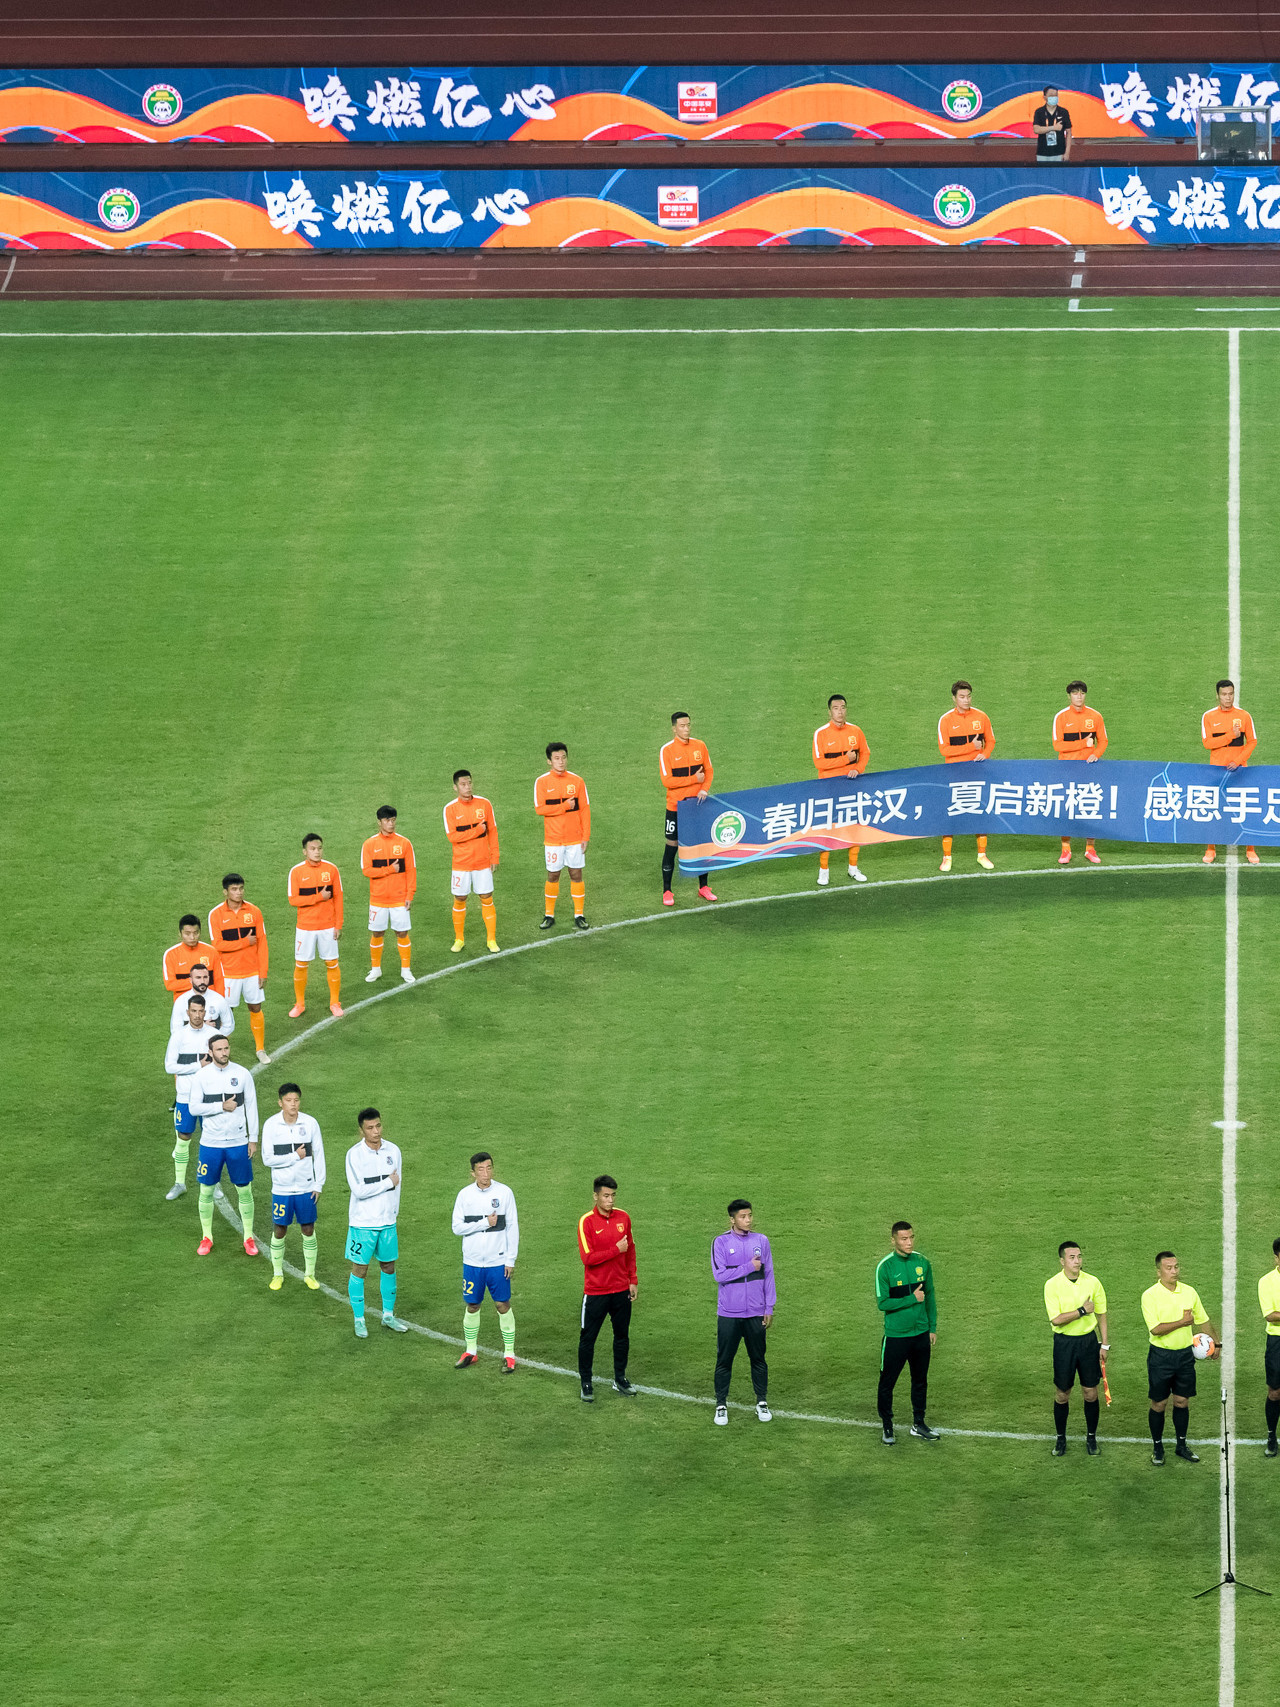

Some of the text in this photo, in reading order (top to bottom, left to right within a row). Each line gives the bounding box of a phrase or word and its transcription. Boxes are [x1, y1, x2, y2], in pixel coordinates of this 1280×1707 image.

[301, 77, 557, 132] 唤燃亿心
[264, 179, 532, 238] 唤燃亿心
[665, 819, 676, 833] 16
[547, 852, 557, 863] 39
[297, 941, 303, 951] 7
[197, 1160, 209, 1176] 26
[273, 1203, 286, 1217] 25
[350, 1240, 363, 1255] 22
